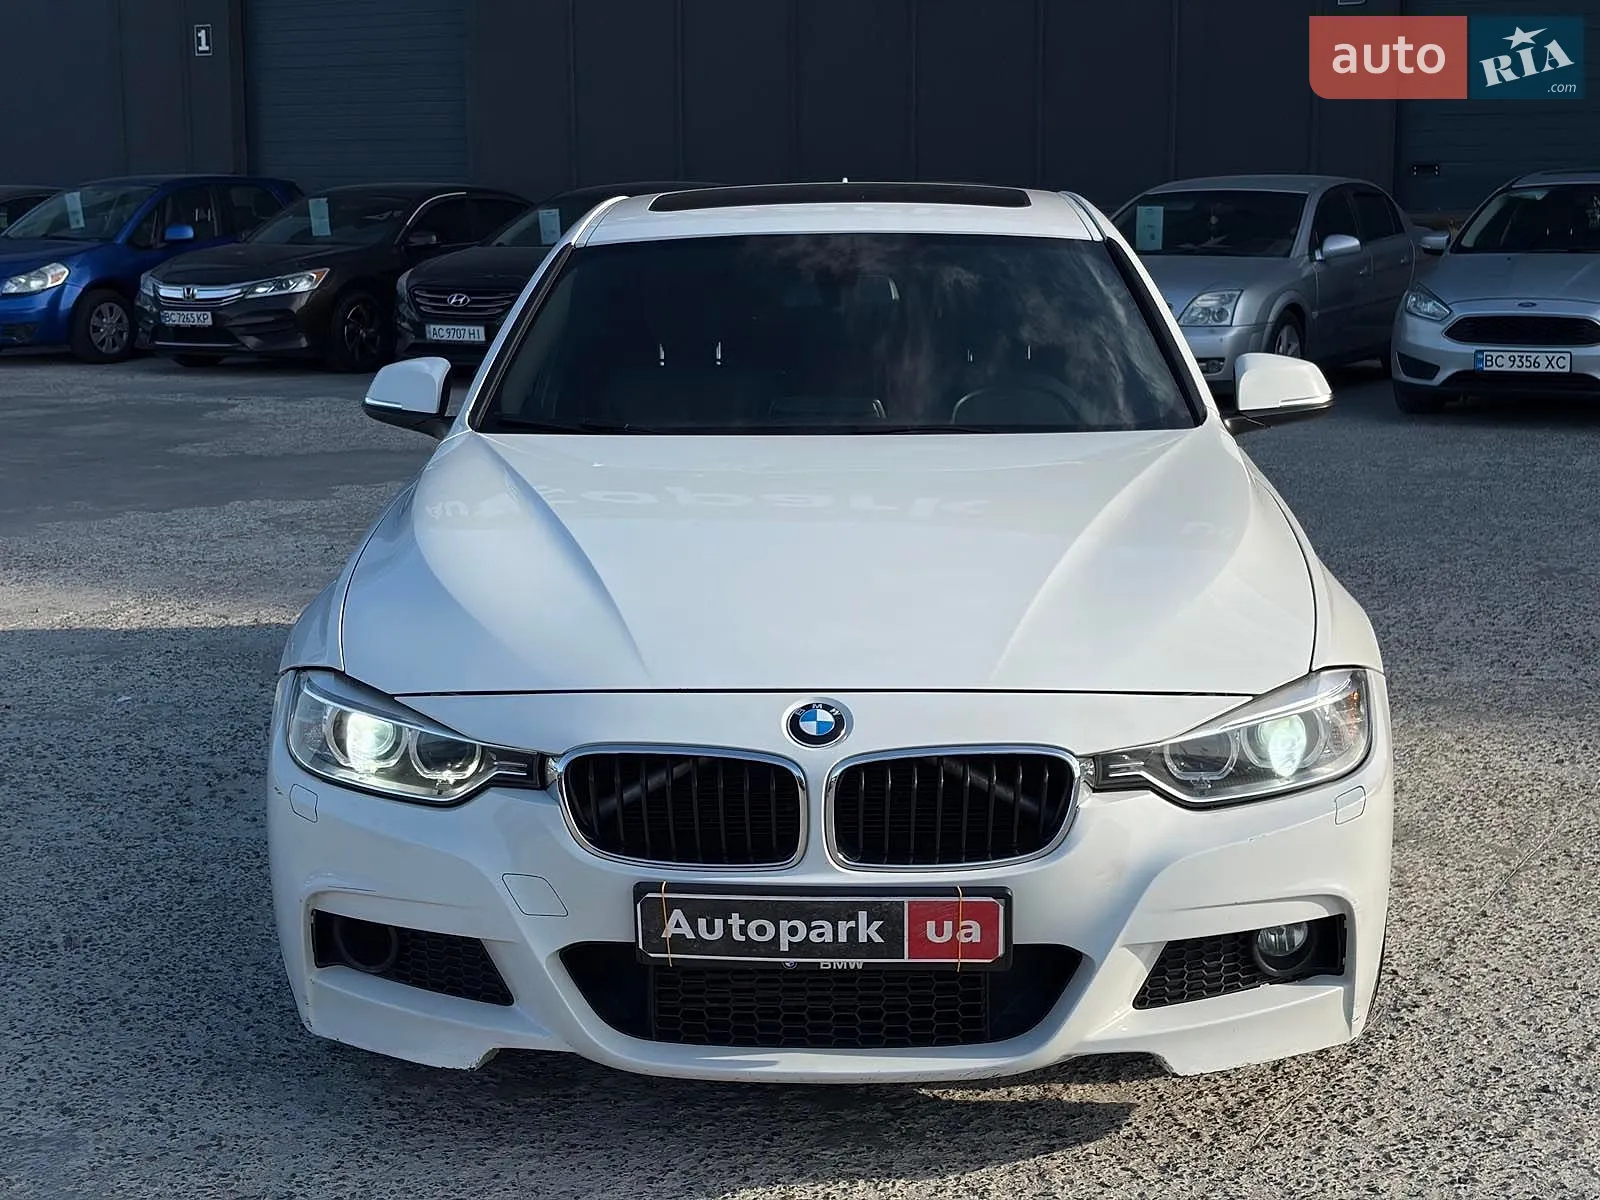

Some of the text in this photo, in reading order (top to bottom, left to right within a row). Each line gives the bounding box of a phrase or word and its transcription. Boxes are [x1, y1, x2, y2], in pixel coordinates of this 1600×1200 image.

[197, 29, 210, 51] 1
[432, 327, 481, 339] AC 9707 HI
[1484, 354, 1566, 369] BC 9356 XC
[794, 703, 841, 716] BMW
[661, 908, 981, 951] Autopark ua
